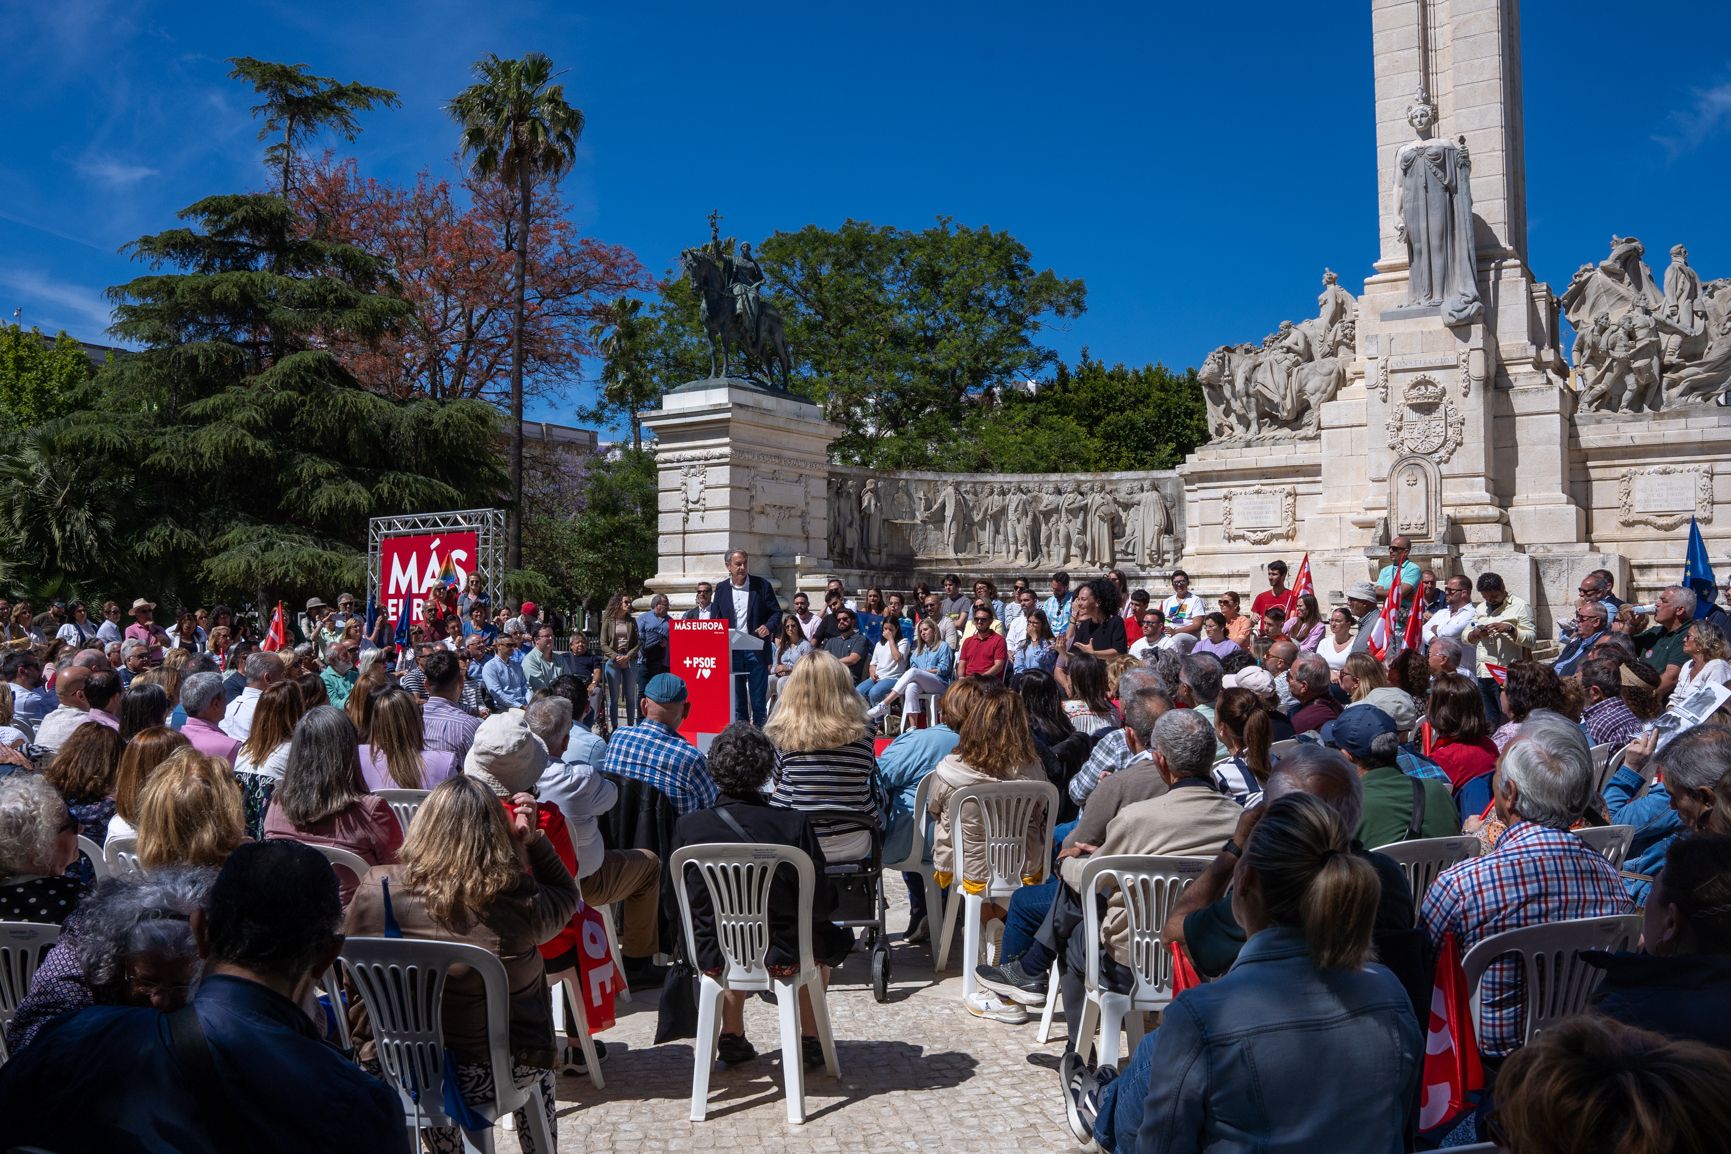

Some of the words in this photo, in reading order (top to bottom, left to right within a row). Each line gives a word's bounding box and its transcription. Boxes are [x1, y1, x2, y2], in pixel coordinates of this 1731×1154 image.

[388, 538, 468, 594] MÁS
[674, 620, 691, 631] MÁS
[692, 622, 724, 631] EUROPA
